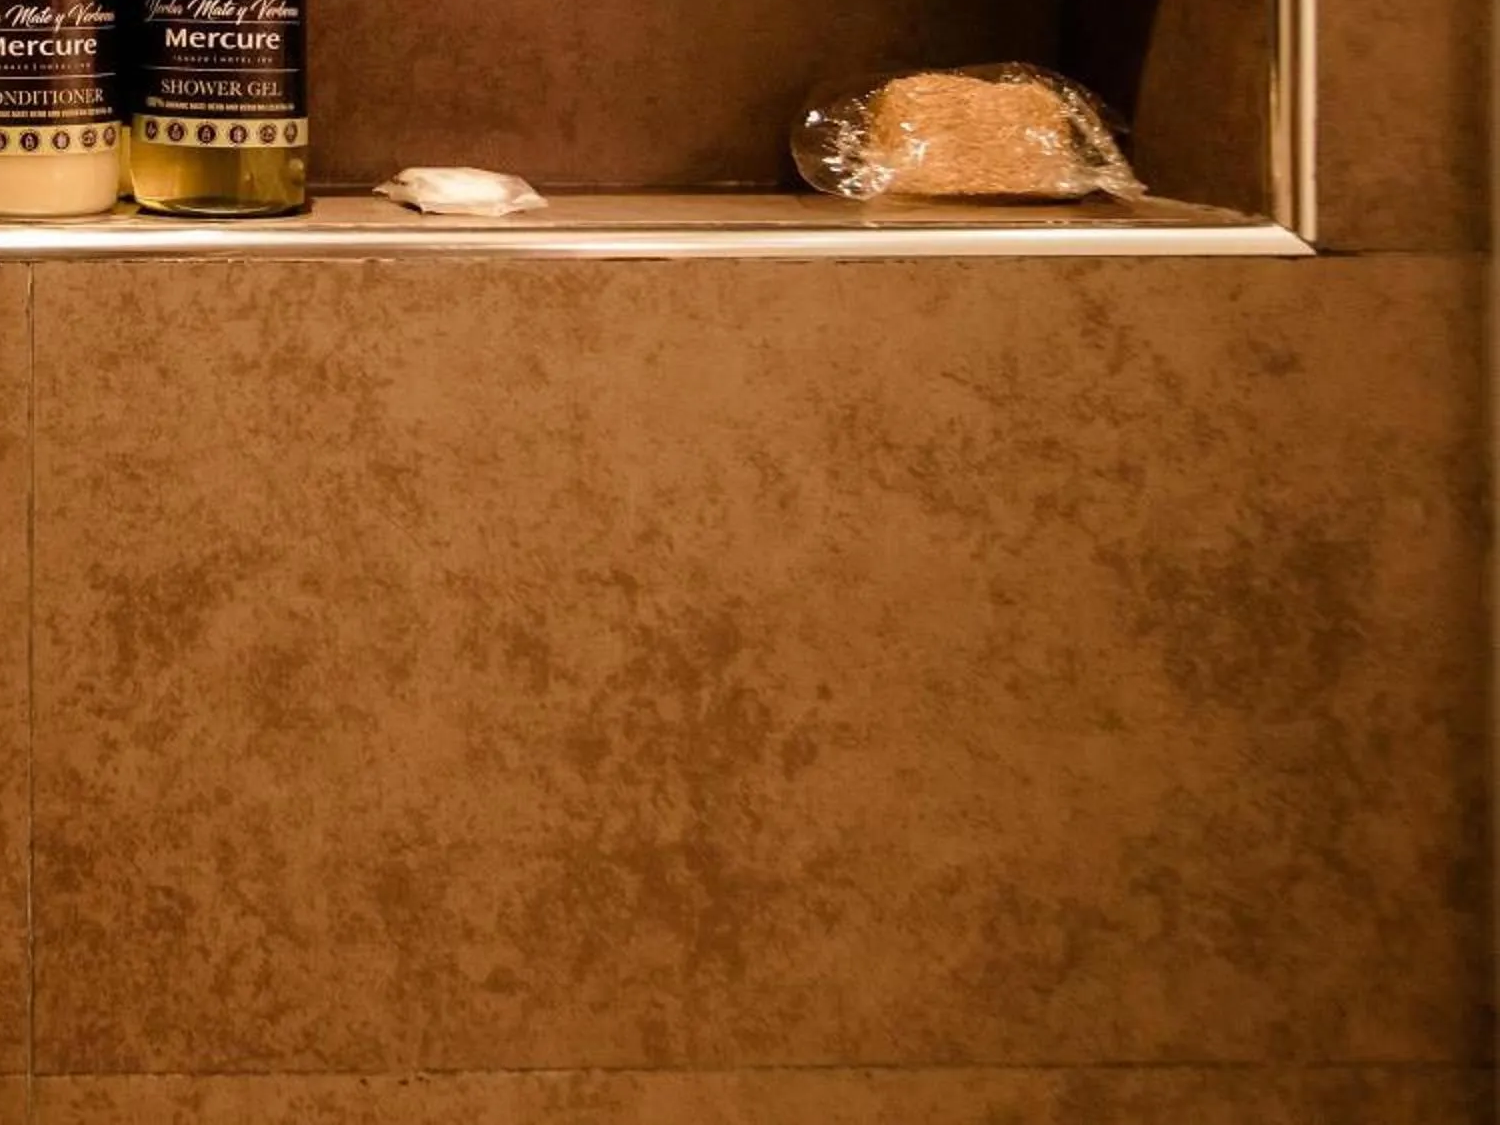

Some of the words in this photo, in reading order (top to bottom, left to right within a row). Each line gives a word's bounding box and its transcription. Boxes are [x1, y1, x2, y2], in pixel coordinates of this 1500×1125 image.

[165, 28, 282, 50] Mercure
[161, 78, 243, 97] SHOWER
[247, 80, 283, 98] GEL
